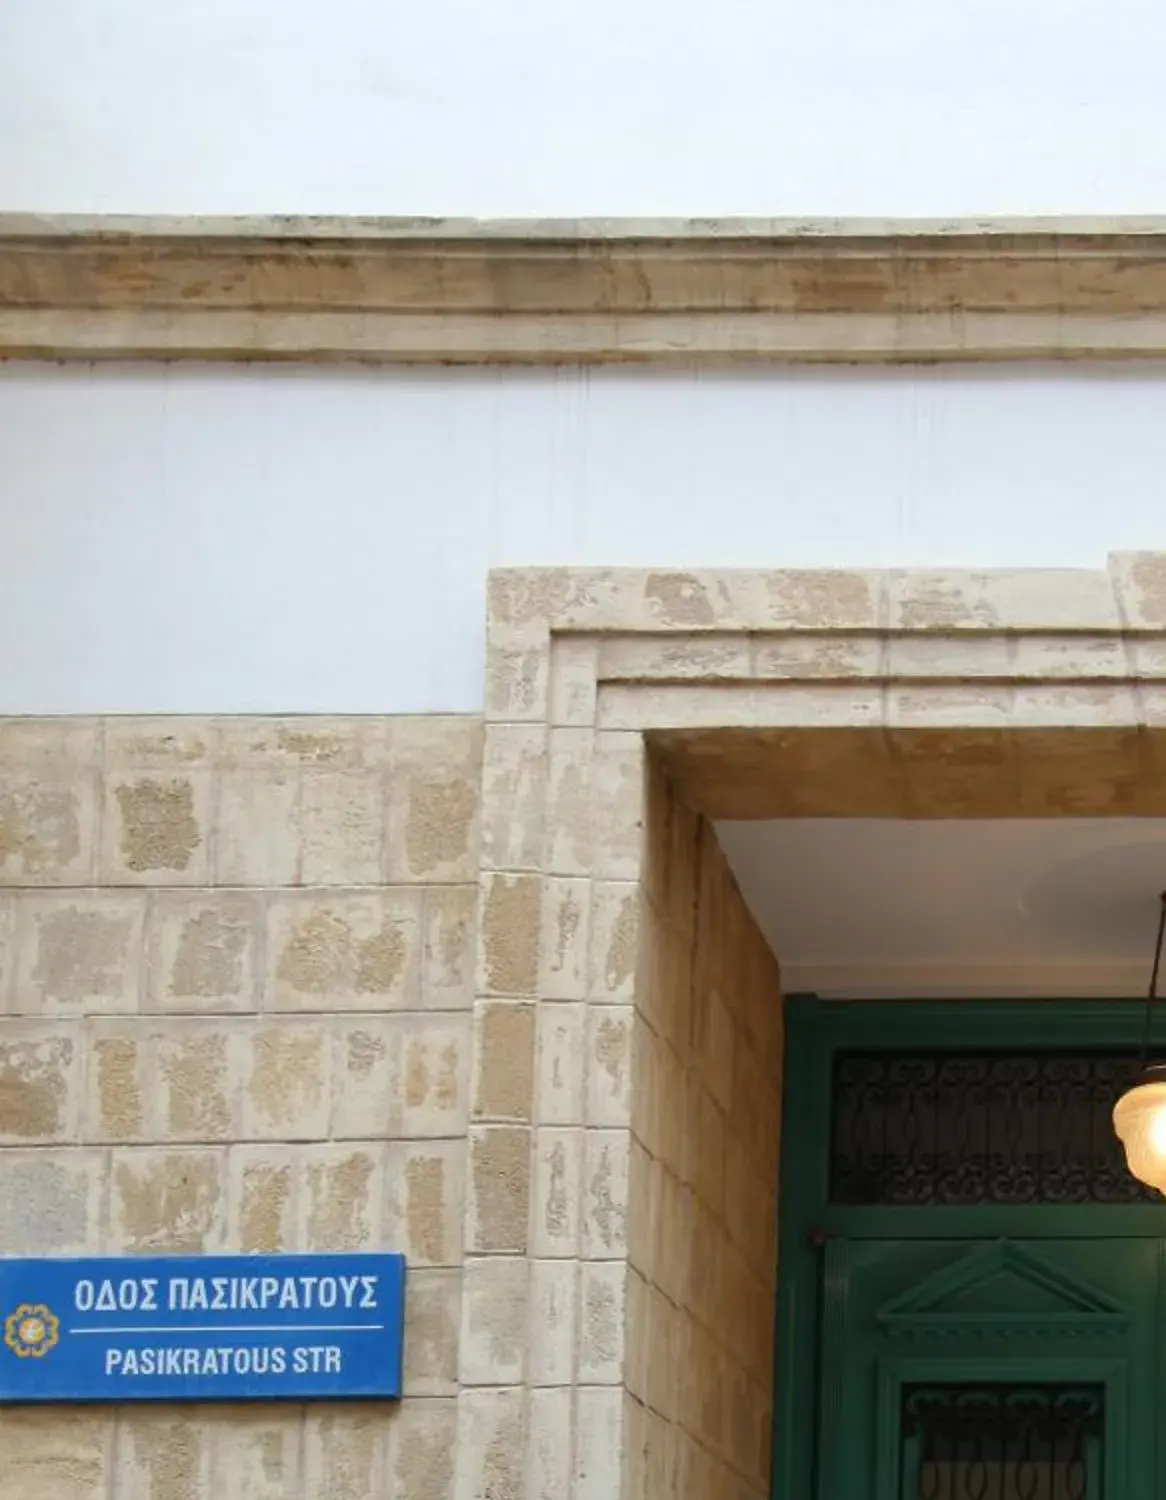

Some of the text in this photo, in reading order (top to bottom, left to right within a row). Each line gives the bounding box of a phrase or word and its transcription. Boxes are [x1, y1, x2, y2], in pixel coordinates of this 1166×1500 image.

[75, 1276, 379, 1312] ΟΔΟΣ ΠΑΣΙΚΡΑΤΟΥΣ
[105, 1346, 341, 1375] PASIKRATOUS STR
